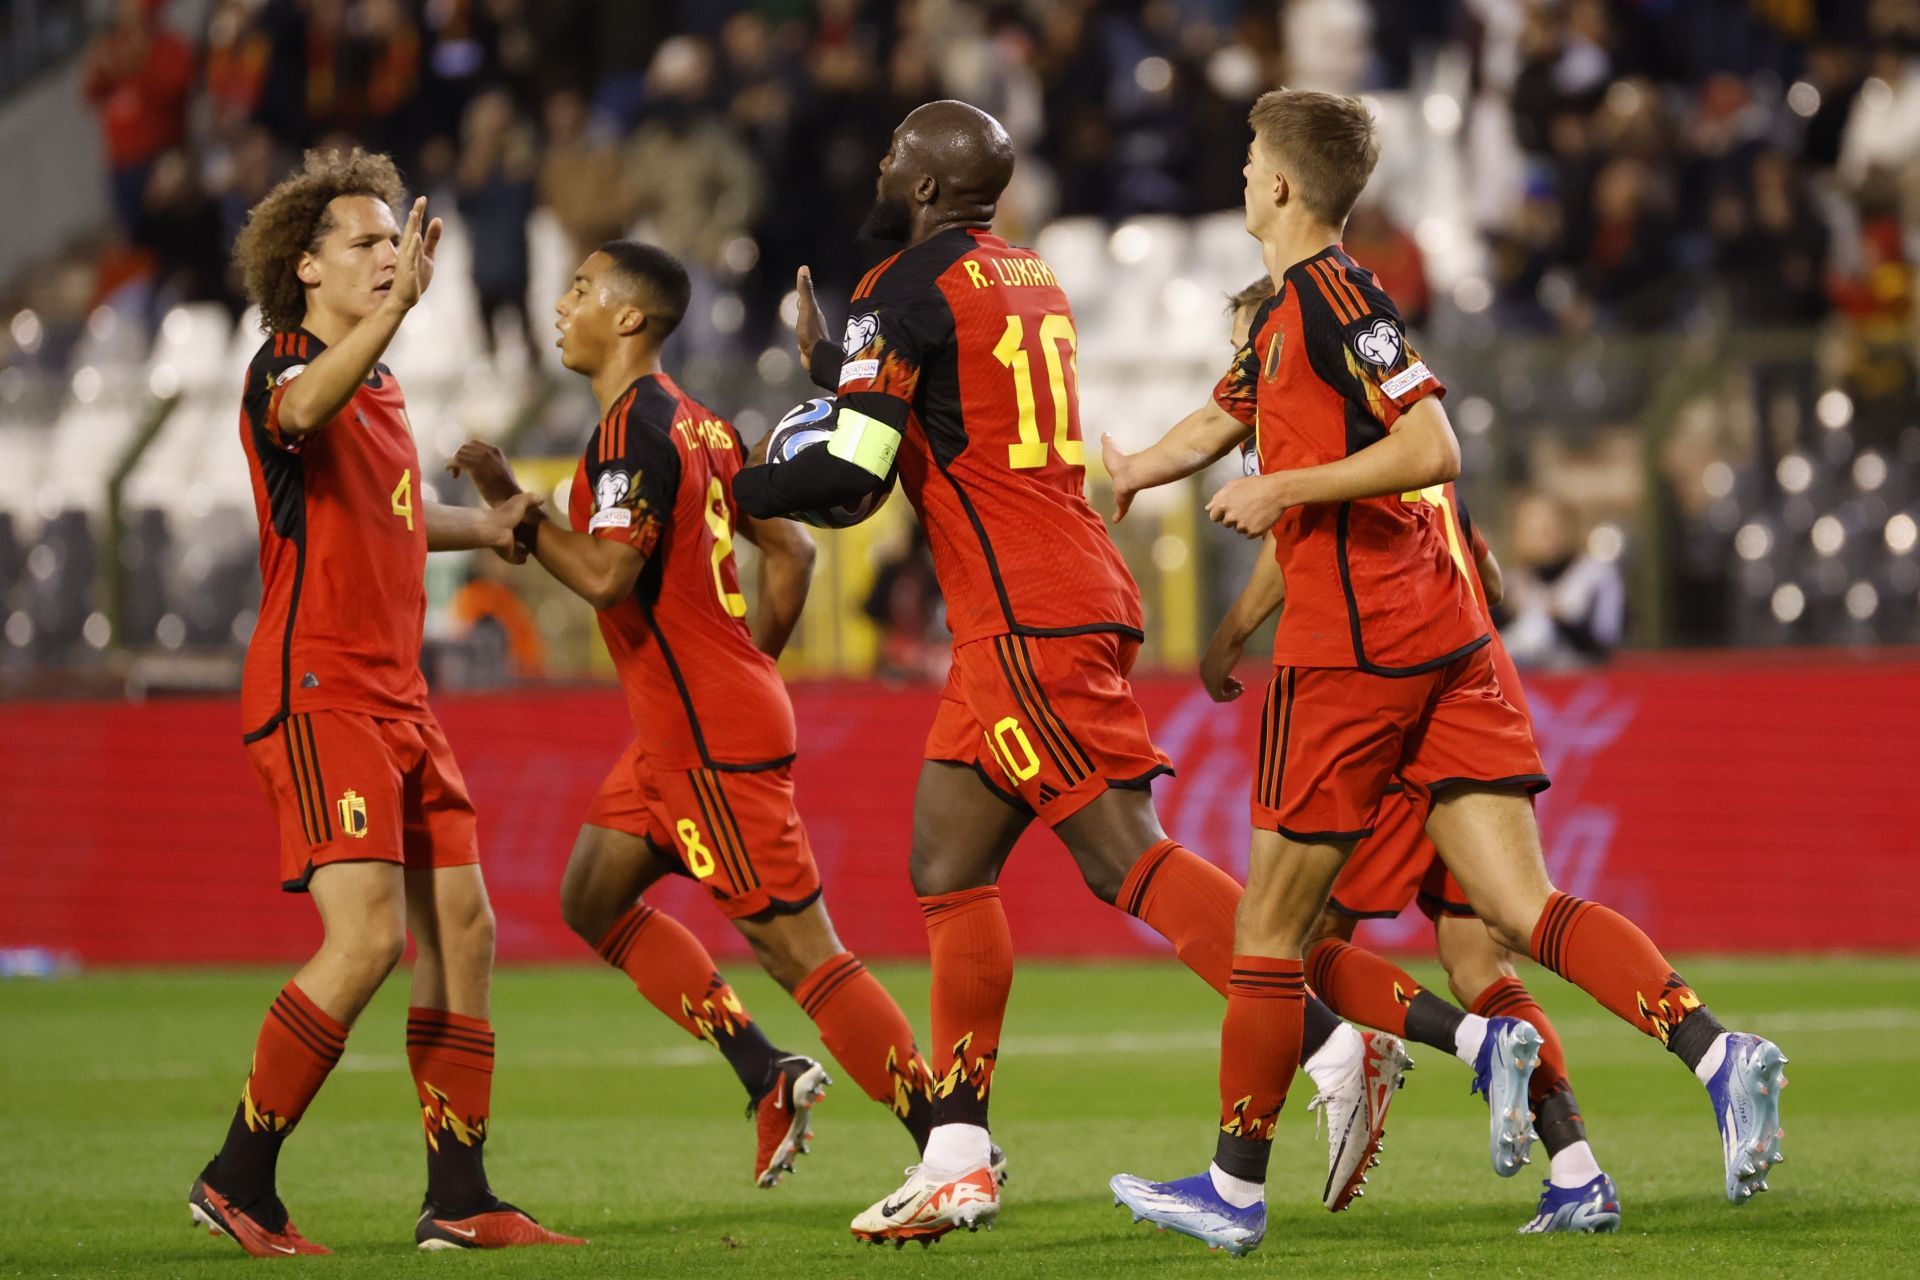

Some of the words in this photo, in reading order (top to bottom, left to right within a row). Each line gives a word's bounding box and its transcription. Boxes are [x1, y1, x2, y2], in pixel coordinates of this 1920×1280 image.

[962, 259, 995, 290] R.
[992, 314, 1085, 470] 10
[391, 469, 414, 531] 4
[983, 715, 1041, 788] 10
[676, 818, 716, 879] 8
